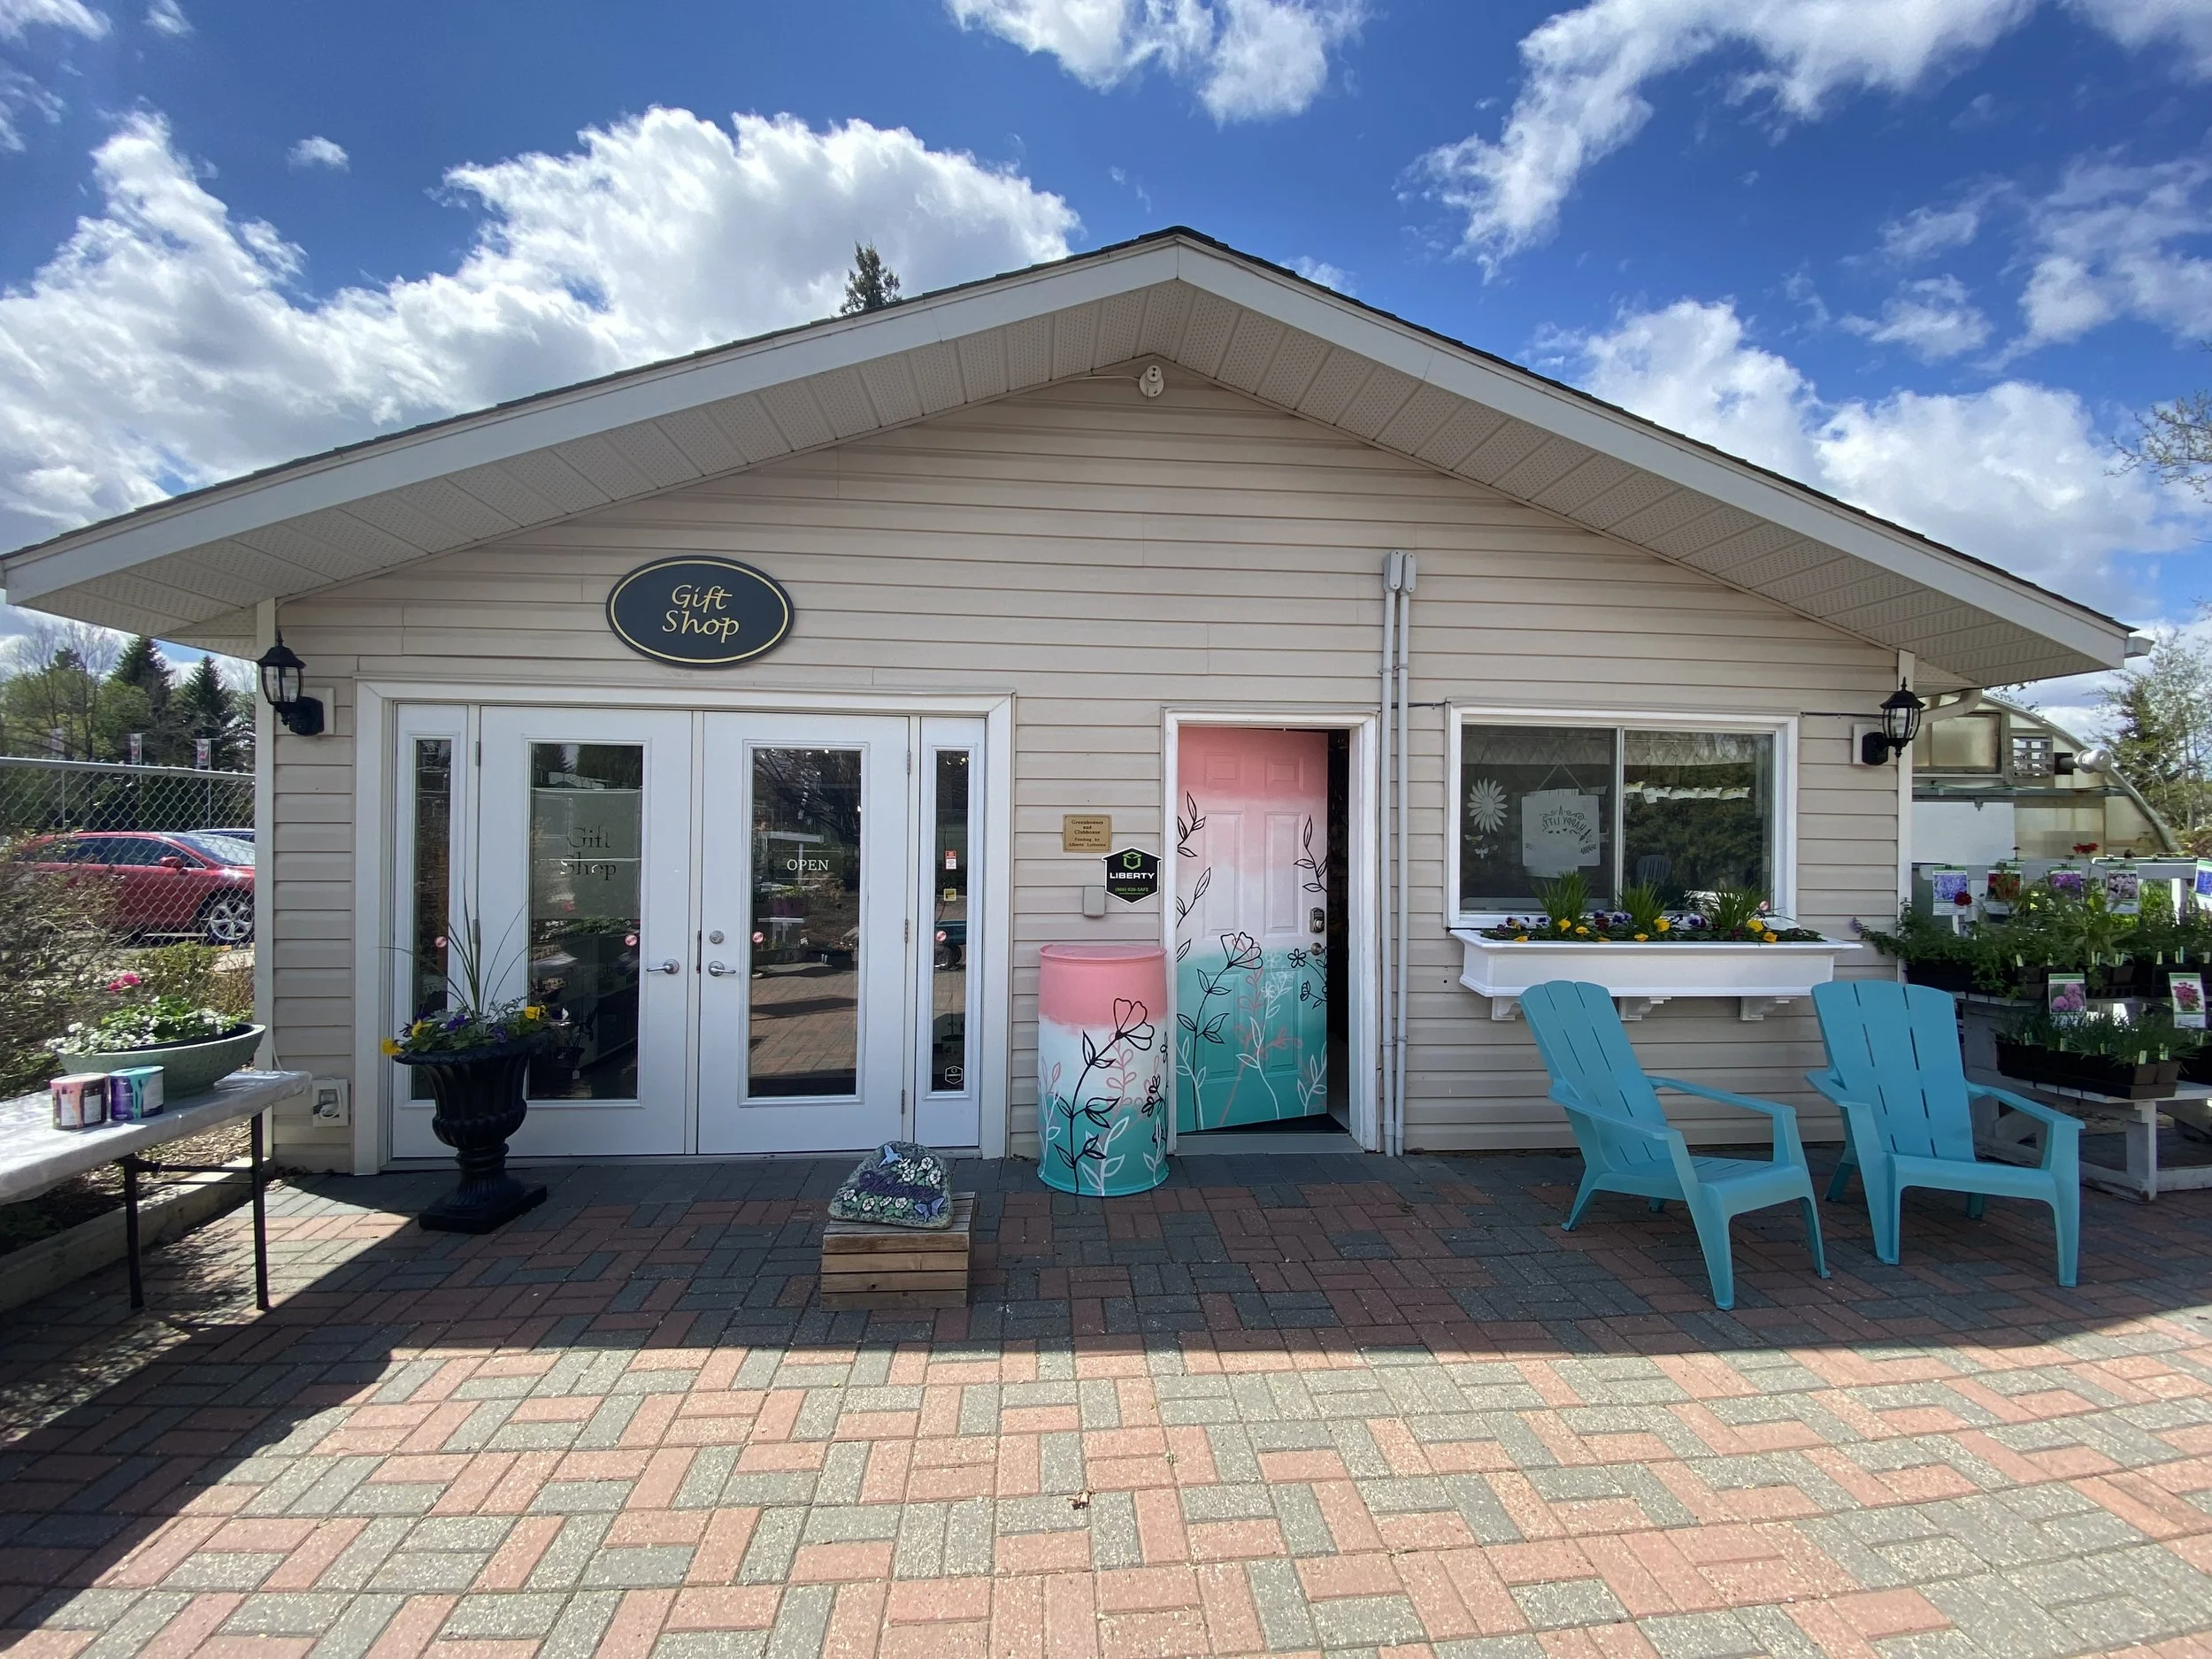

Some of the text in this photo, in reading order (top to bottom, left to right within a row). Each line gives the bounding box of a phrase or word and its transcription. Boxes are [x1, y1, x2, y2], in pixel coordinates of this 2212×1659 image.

[672, 584, 733, 613] Gift
[662, 609, 740, 643] Shop
[567, 826, 611, 849] Gift
[559, 851, 617, 881] Shop
[787, 859, 829, 871] OPEN
